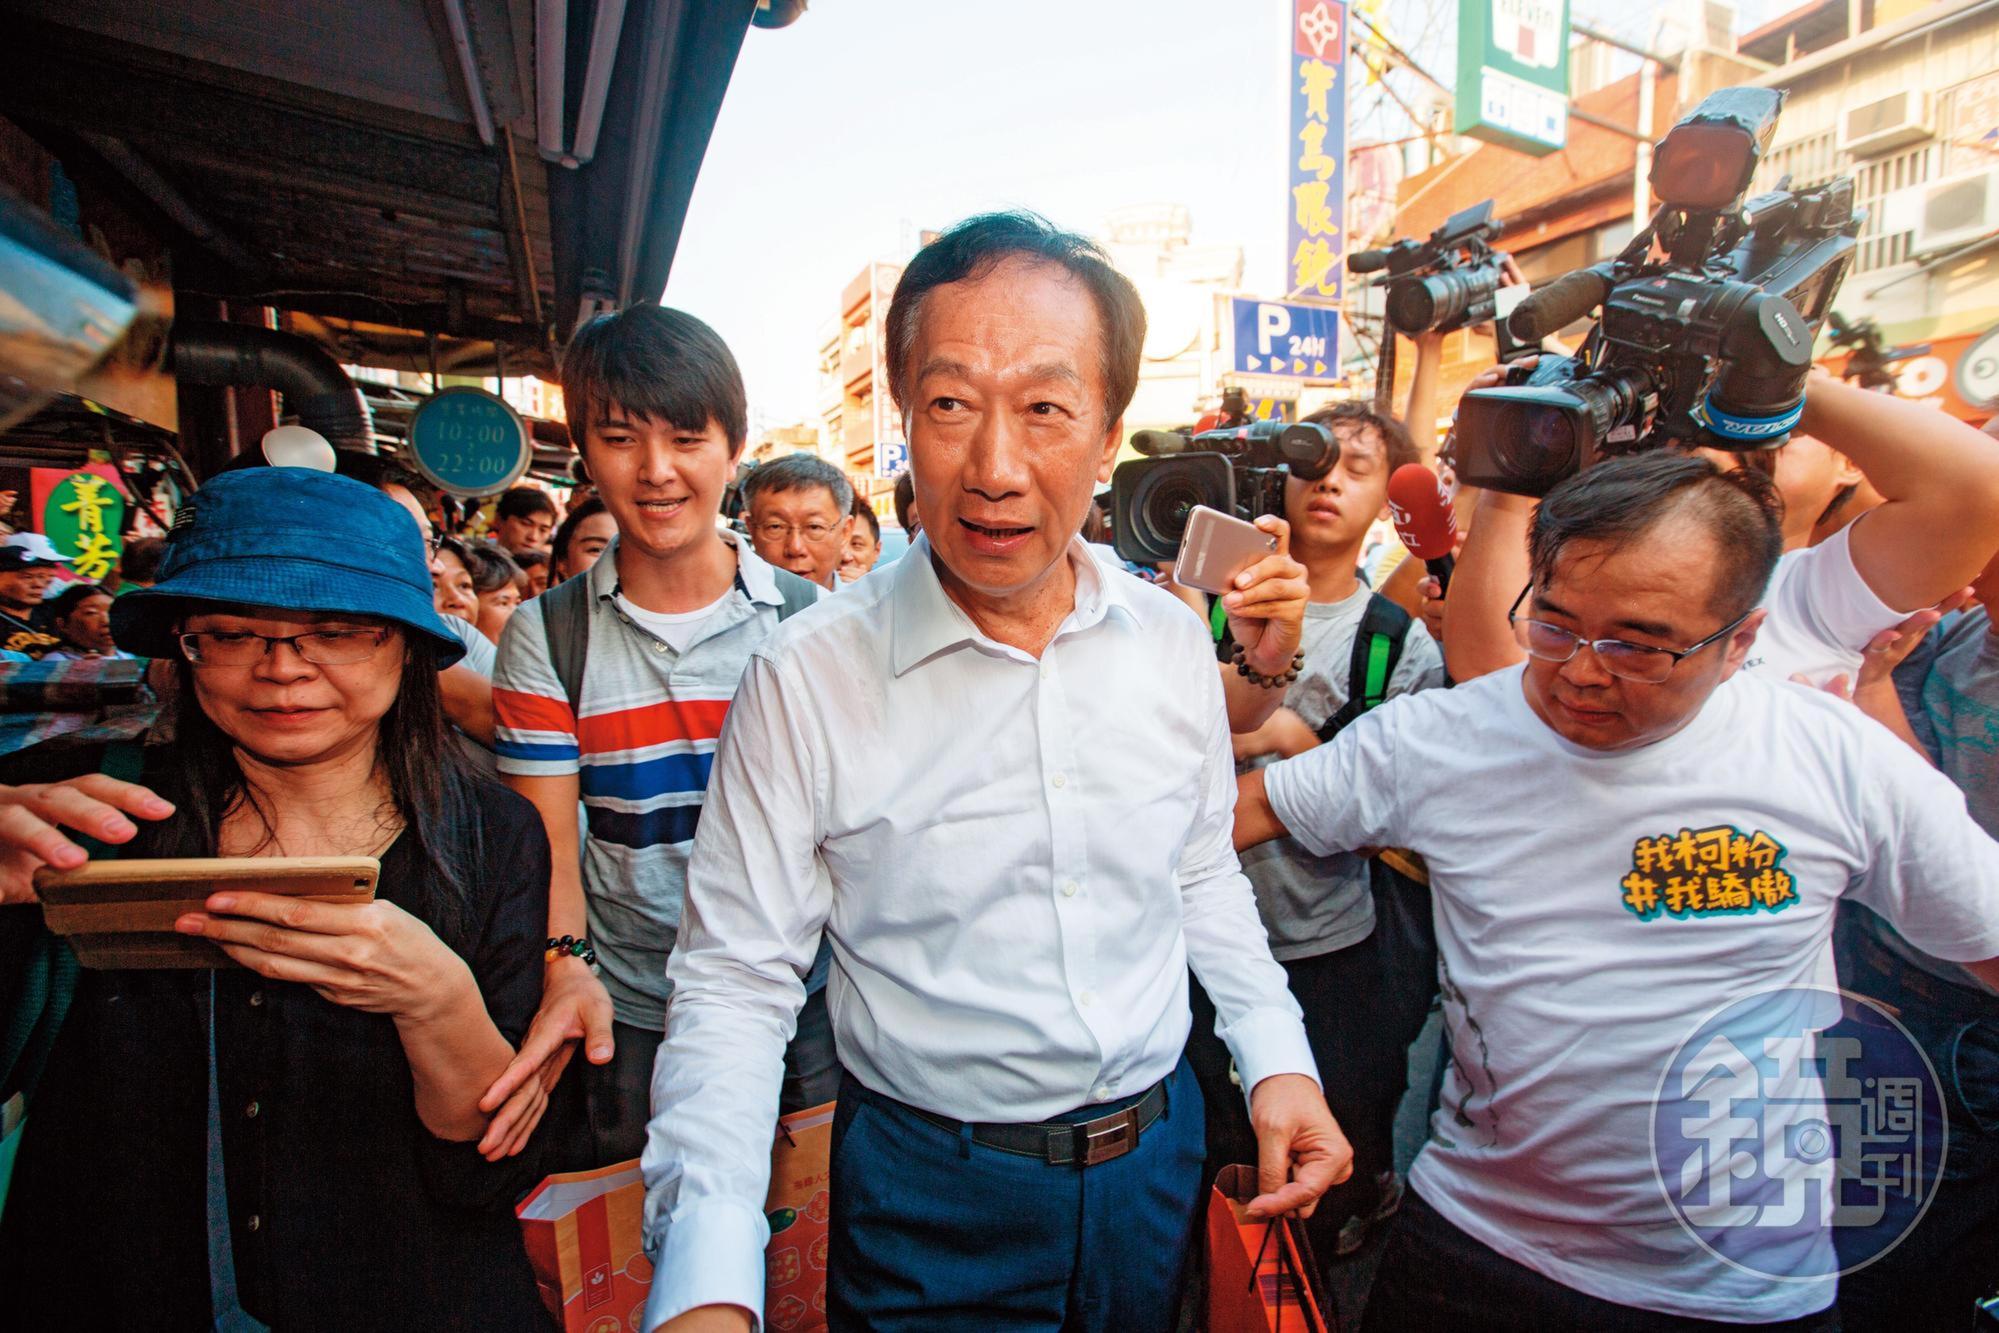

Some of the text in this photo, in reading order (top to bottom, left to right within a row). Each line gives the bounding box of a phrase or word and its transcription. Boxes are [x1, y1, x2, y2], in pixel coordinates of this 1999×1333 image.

[1258, 303, 1291, 355] P
[1288, 335, 1326, 358] 24H
[439, 421, 505, 444] 10:00
[437, 453, 506, 474] 22:00
[882, 444, 902, 470] P
[1634, 828, 1780, 873] 我柯粉
[1622, 868, 1794, 912] #我驕傲
